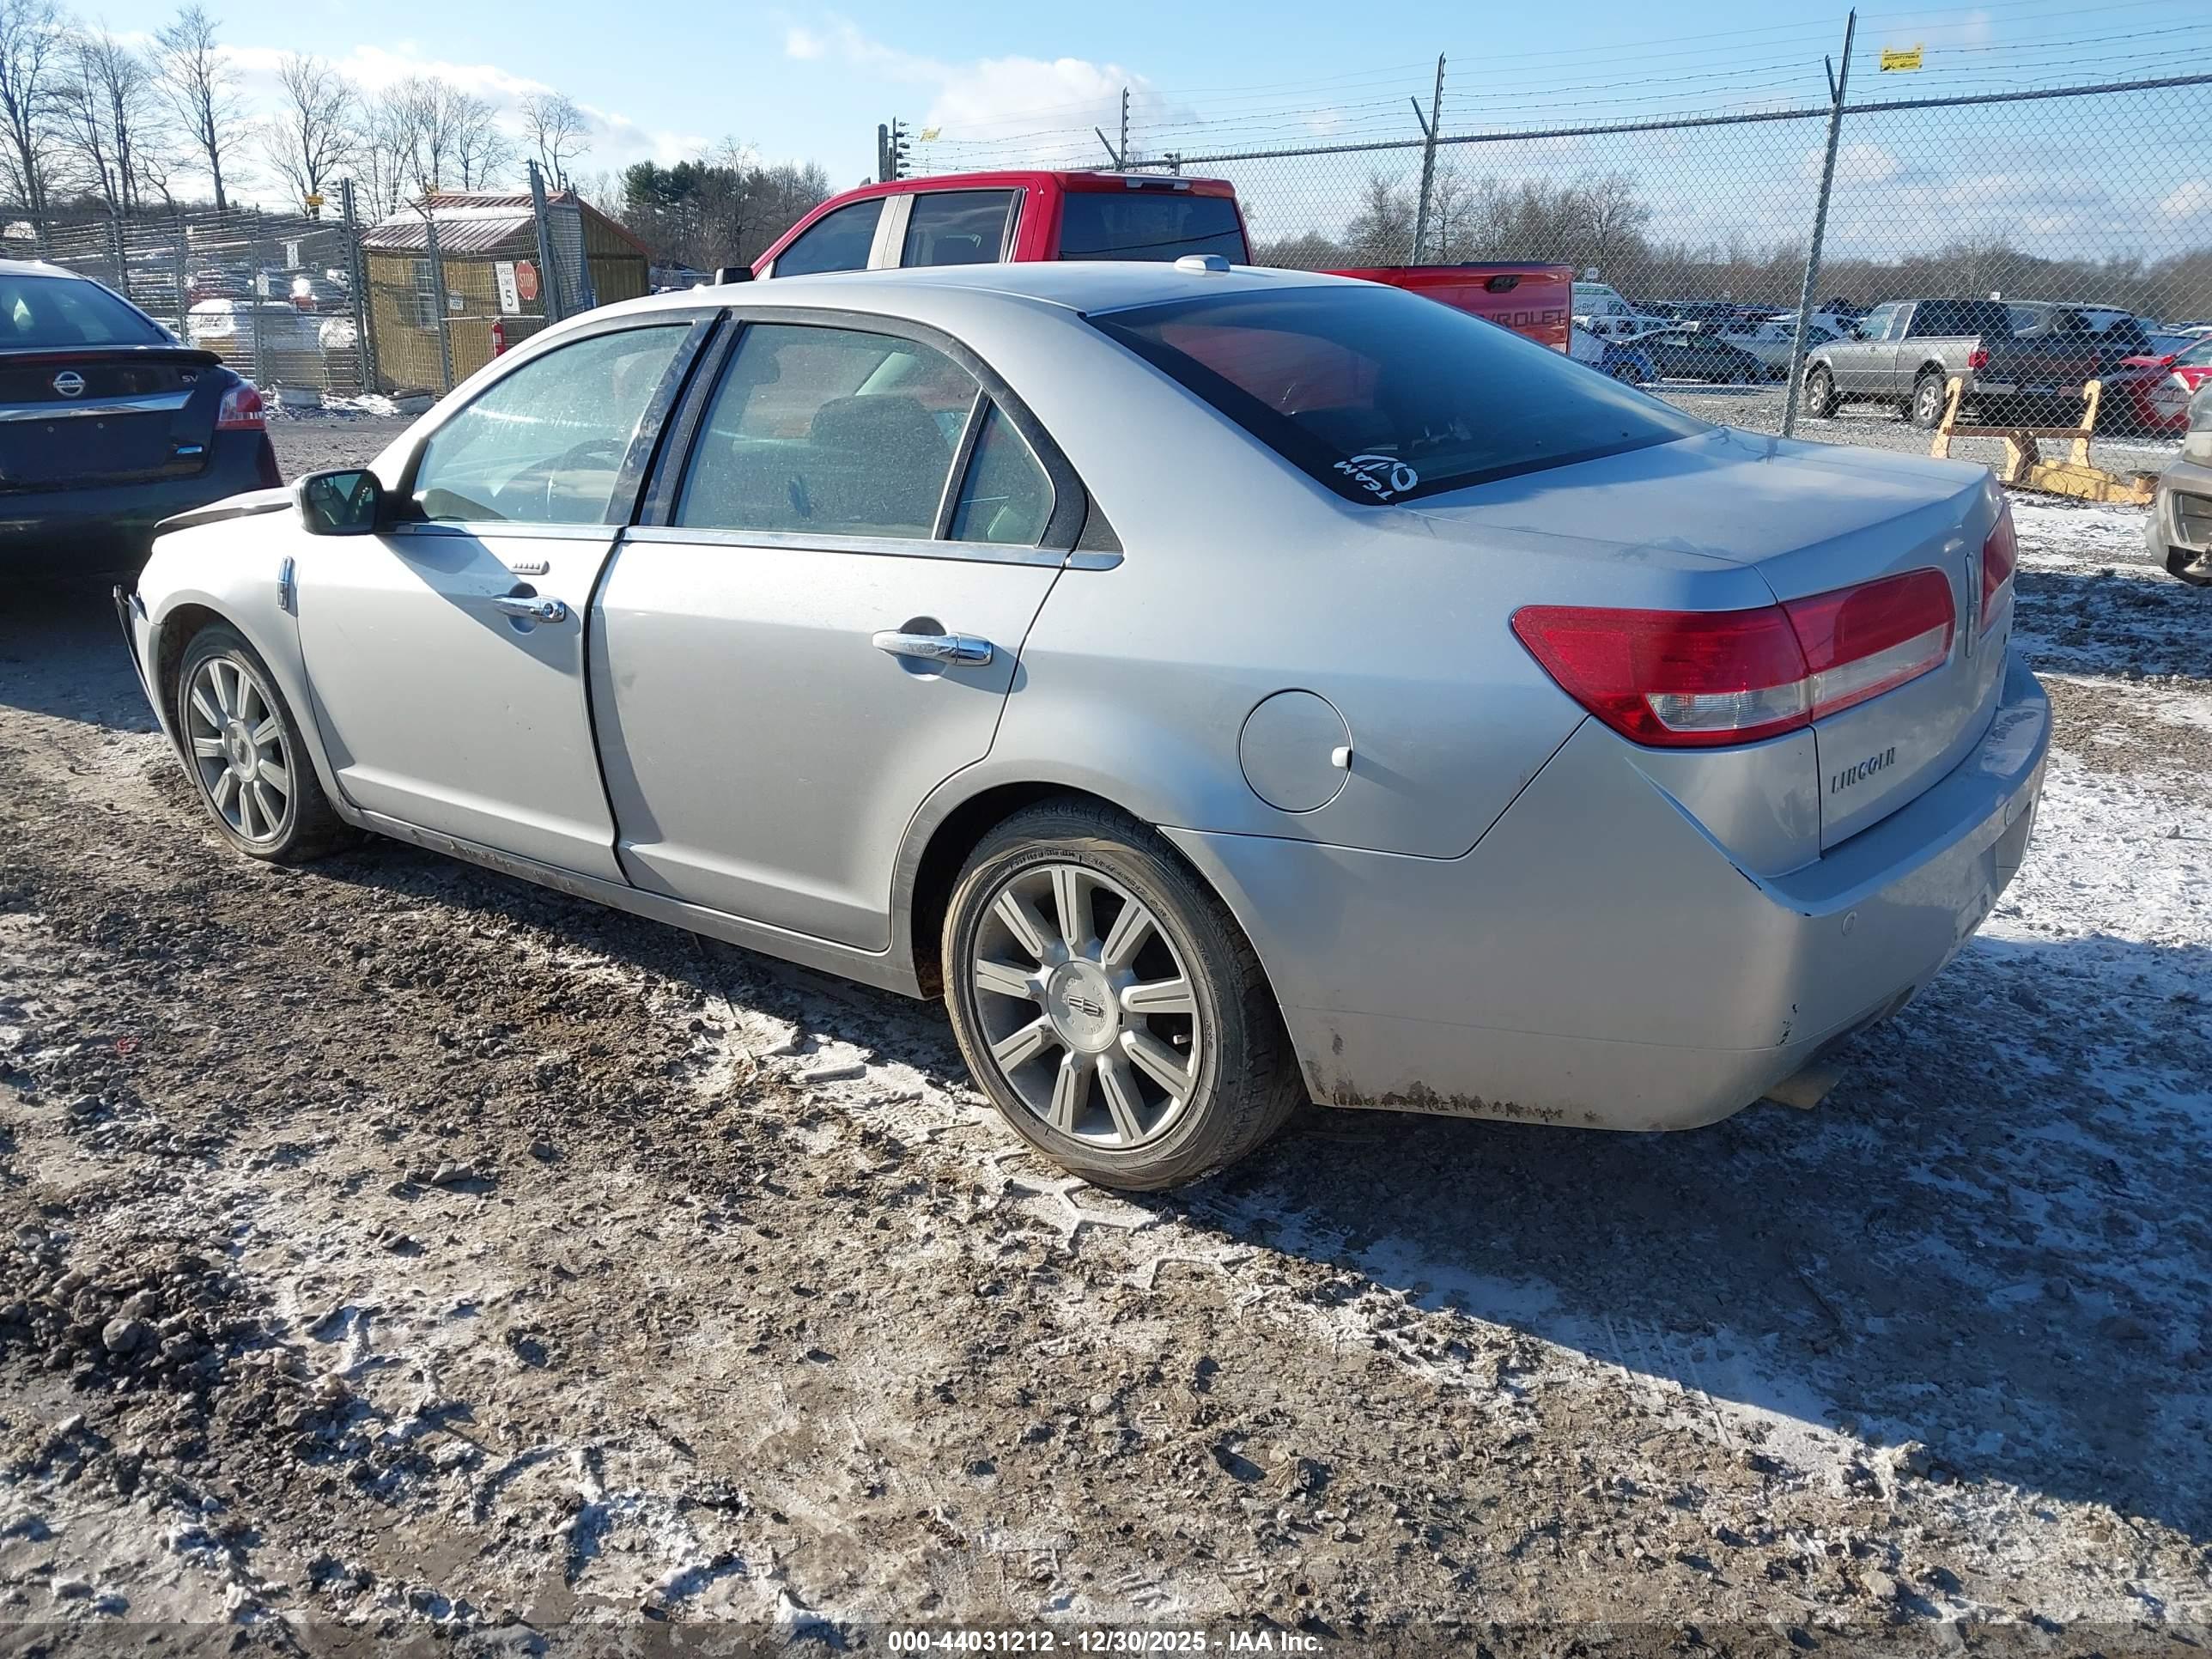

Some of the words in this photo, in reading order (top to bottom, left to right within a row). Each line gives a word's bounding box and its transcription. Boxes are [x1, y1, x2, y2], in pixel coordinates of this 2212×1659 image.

[519, 273, 534, 288] STOP
[505, 289, 514, 307] 5
[1334, 460, 1394, 501] TEAM
[1831, 746, 1897, 794] LINCOLN
